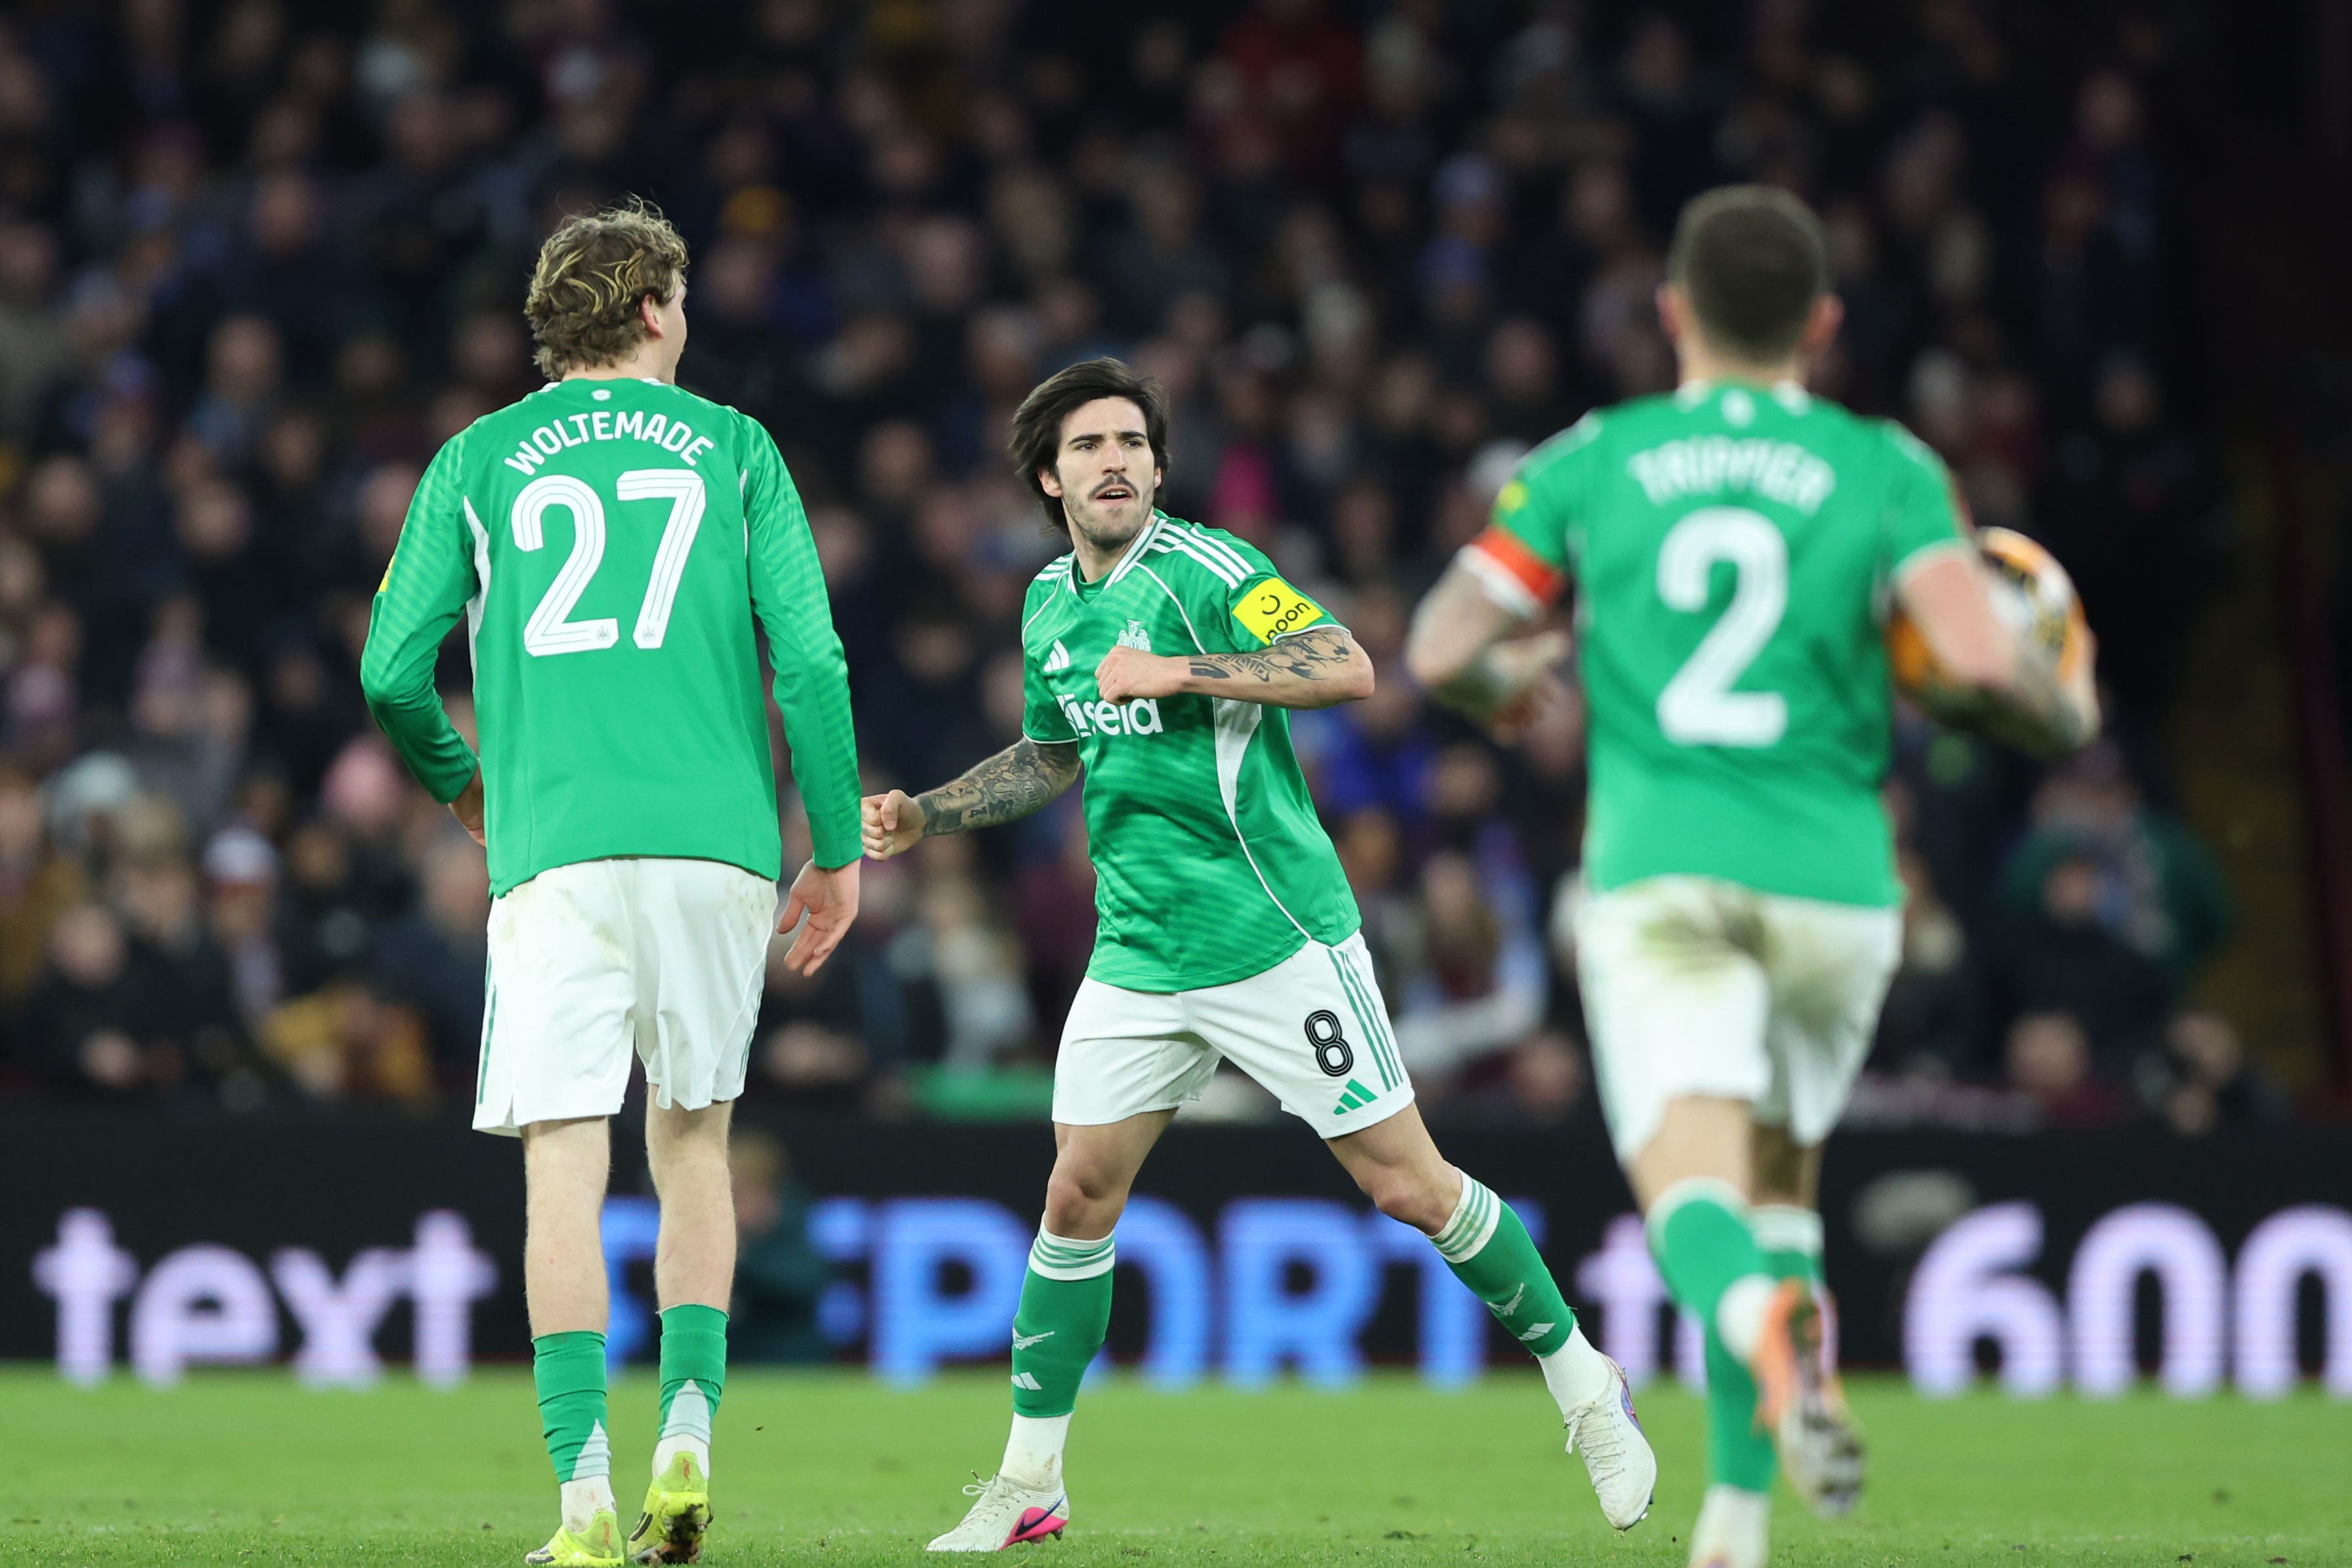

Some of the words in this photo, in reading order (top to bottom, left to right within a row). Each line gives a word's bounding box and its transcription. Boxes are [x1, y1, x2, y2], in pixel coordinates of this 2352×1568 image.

[504, 410, 714, 476] WOLTEMADE
[511, 469, 707, 657] 27
[1265, 602, 1311, 641] noon
[1657, 506, 1788, 748] 2
[1304, 1009, 1354, 1077] 8
[32, 1207, 499, 1389] text
